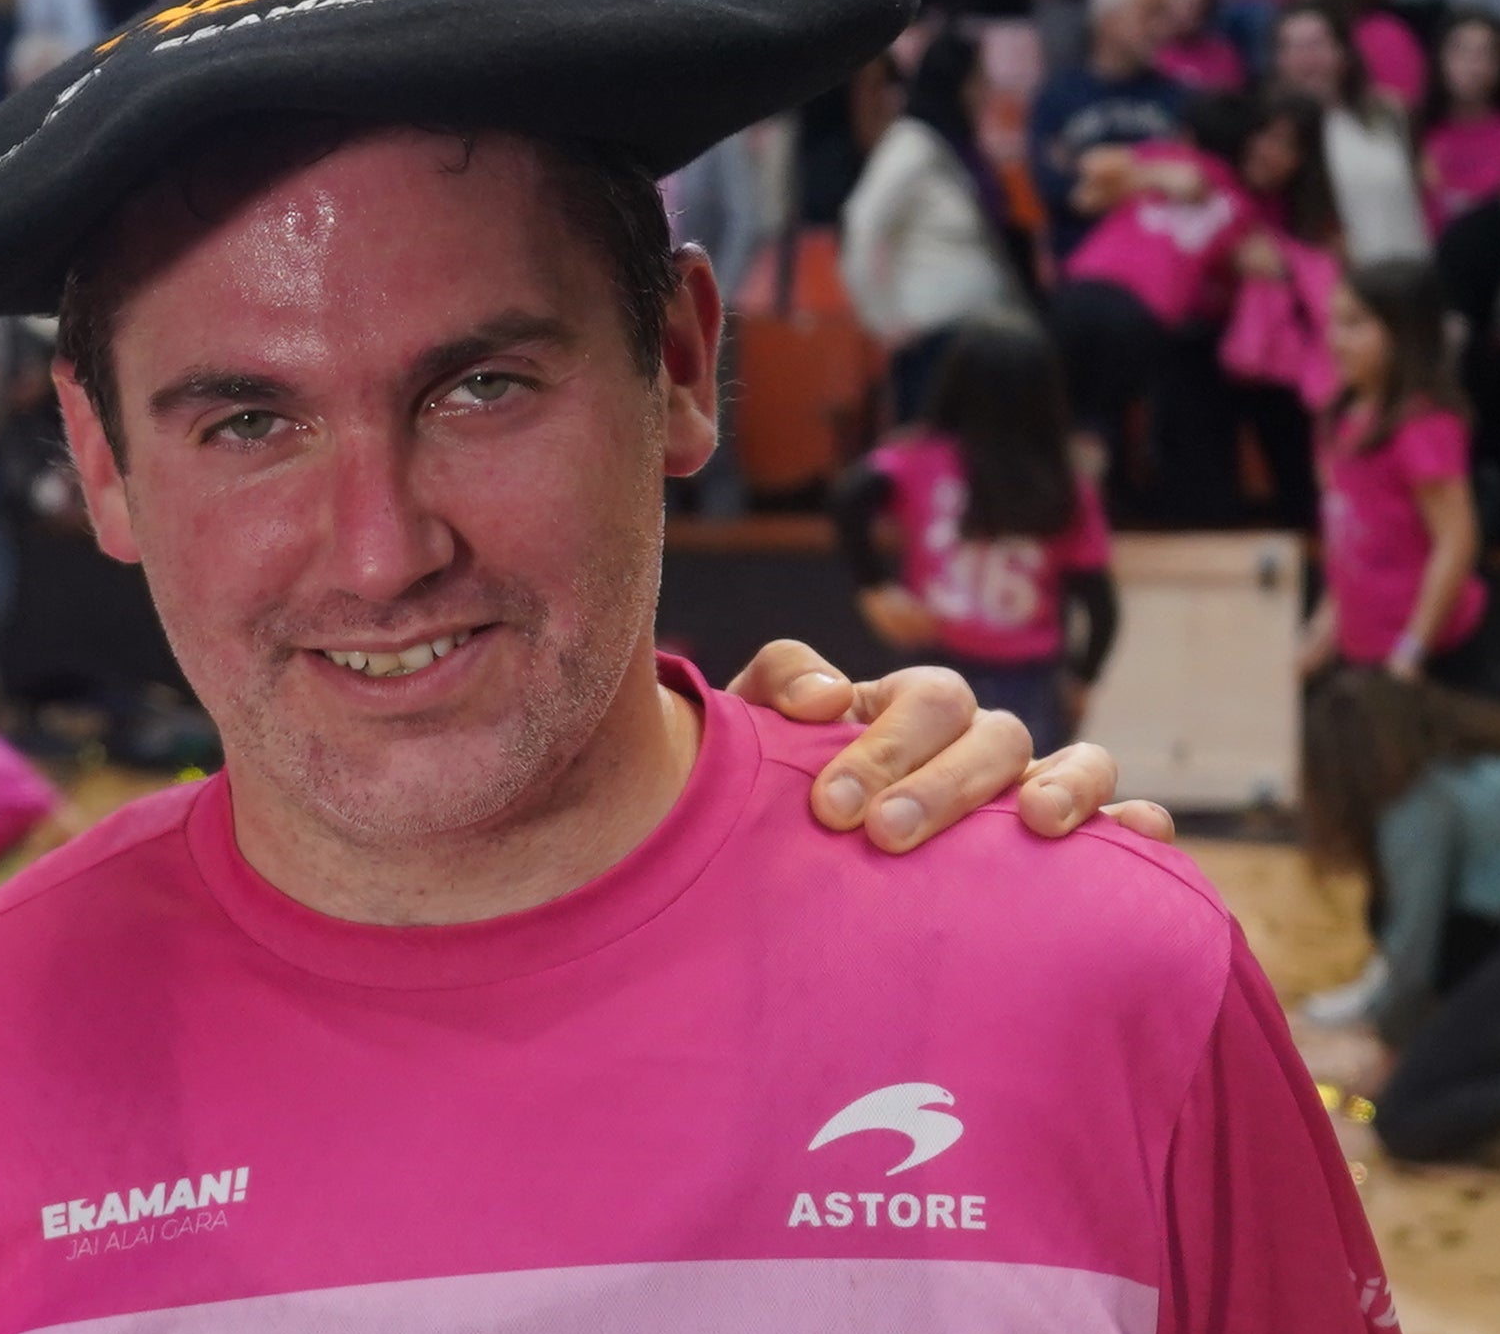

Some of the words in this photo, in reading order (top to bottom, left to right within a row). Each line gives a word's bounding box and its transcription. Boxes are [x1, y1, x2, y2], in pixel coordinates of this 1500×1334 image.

[41, 1166, 249, 1240] ERAMAN!
[788, 1192, 986, 1230] ASTORE
[66, 1237, 98, 1260] JAI
[104, 1225, 155, 1252] ALAI
